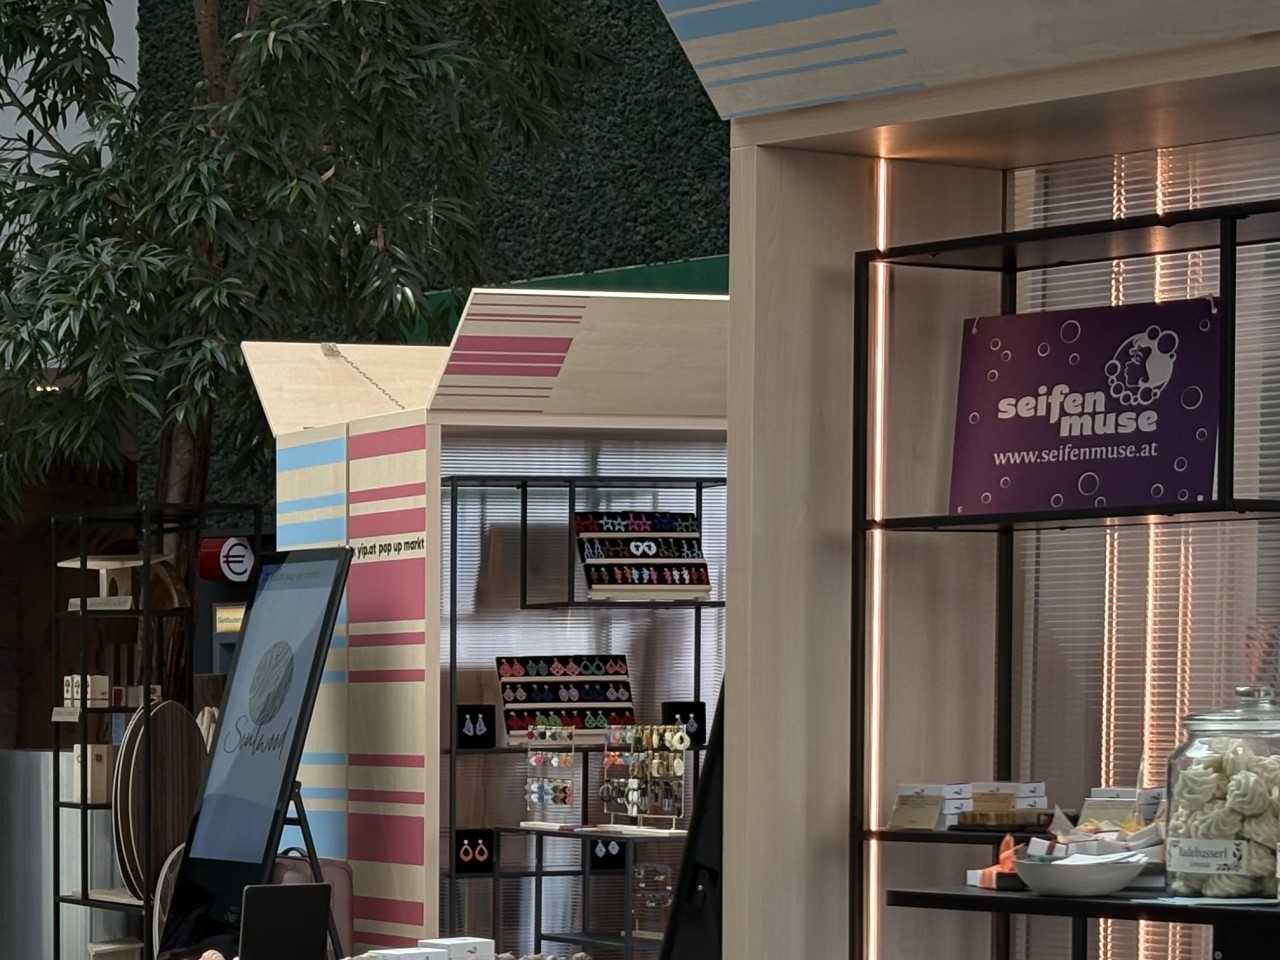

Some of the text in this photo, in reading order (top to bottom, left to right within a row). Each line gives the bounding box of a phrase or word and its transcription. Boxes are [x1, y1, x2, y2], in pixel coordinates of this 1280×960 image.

[997, 383, 1106, 424] seifen
[1059, 410, 1158, 437] muse
[993, 442, 1158, 465] www.seifenmuse.at
[357, 536, 424, 559] yip.at pop up markt
